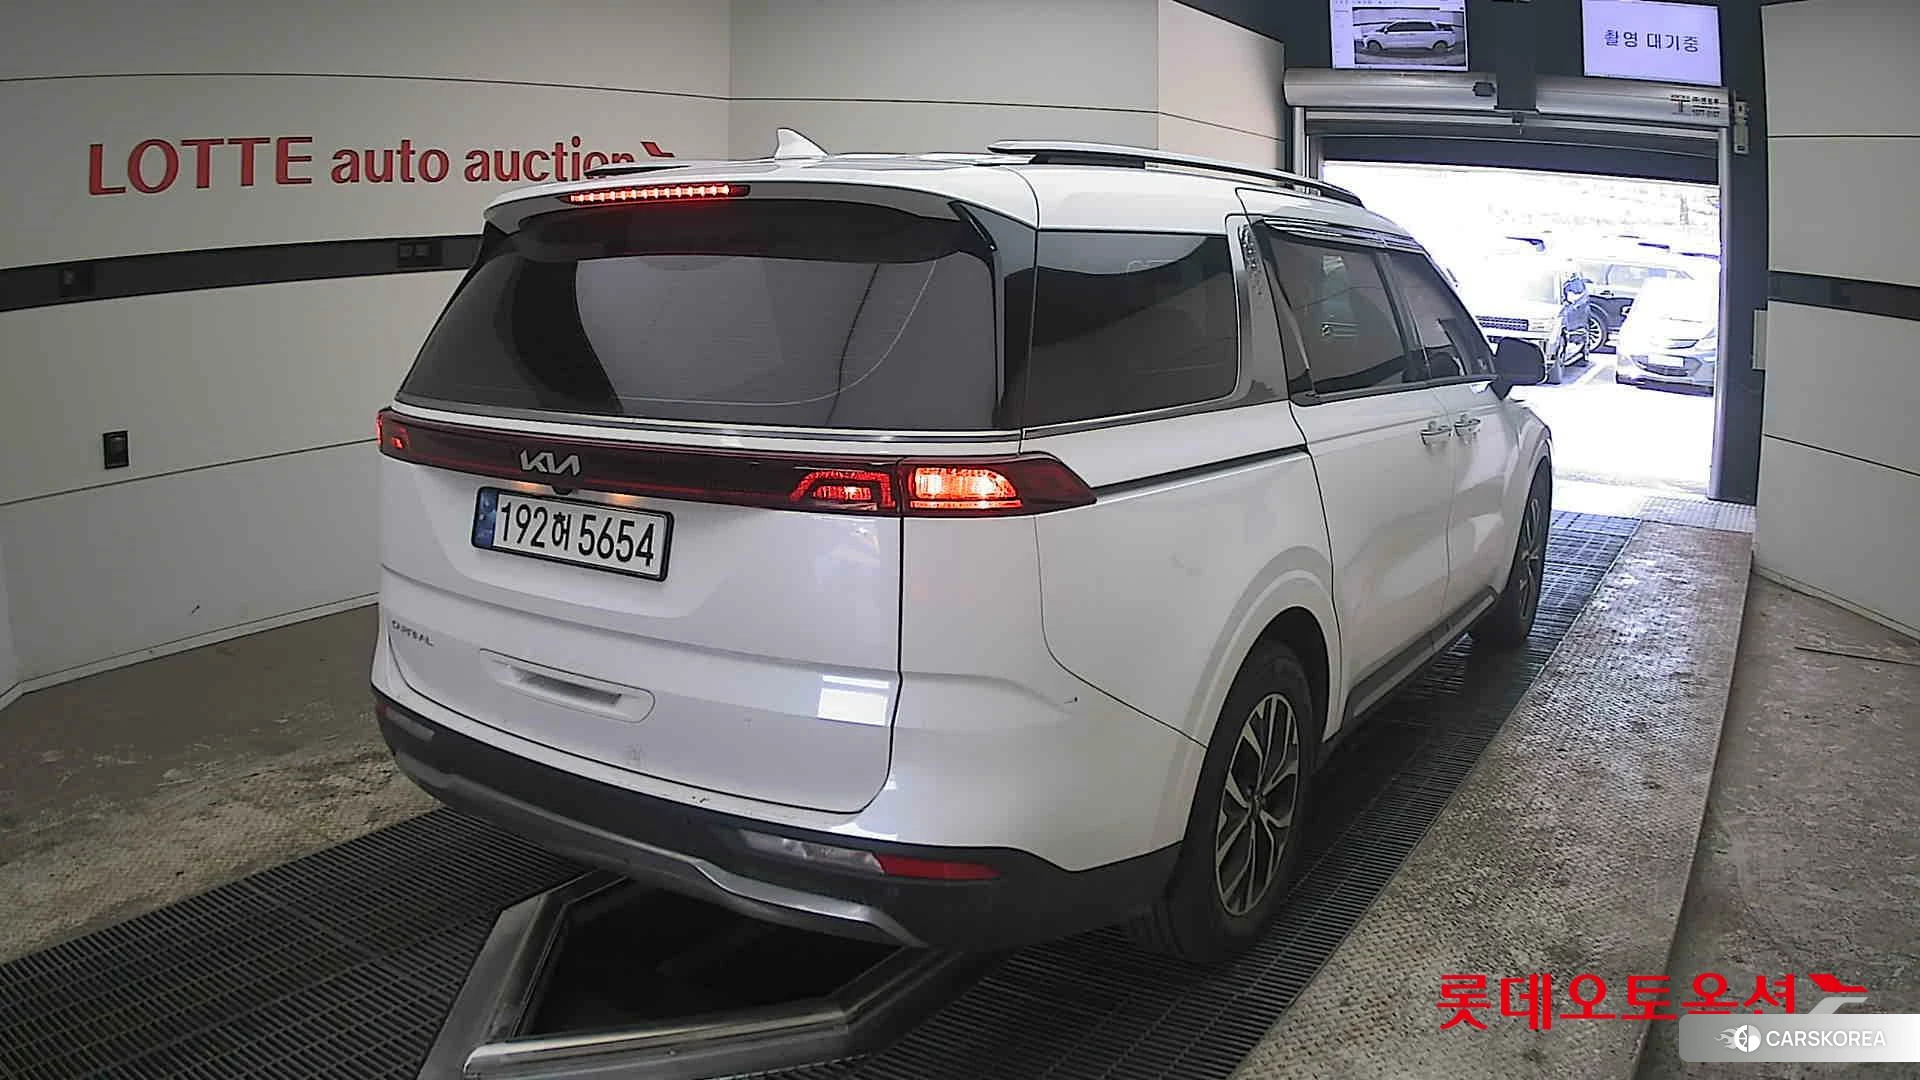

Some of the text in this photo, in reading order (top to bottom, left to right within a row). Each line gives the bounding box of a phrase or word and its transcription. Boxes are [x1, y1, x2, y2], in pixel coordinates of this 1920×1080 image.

[1646, 32, 1699, 53] 대기중
[89, 136, 313, 196] LOTTE
[331, 139, 450, 183] auto
[520, 448, 580, 477] KIA
[578, 513, 654, 567] 5654
